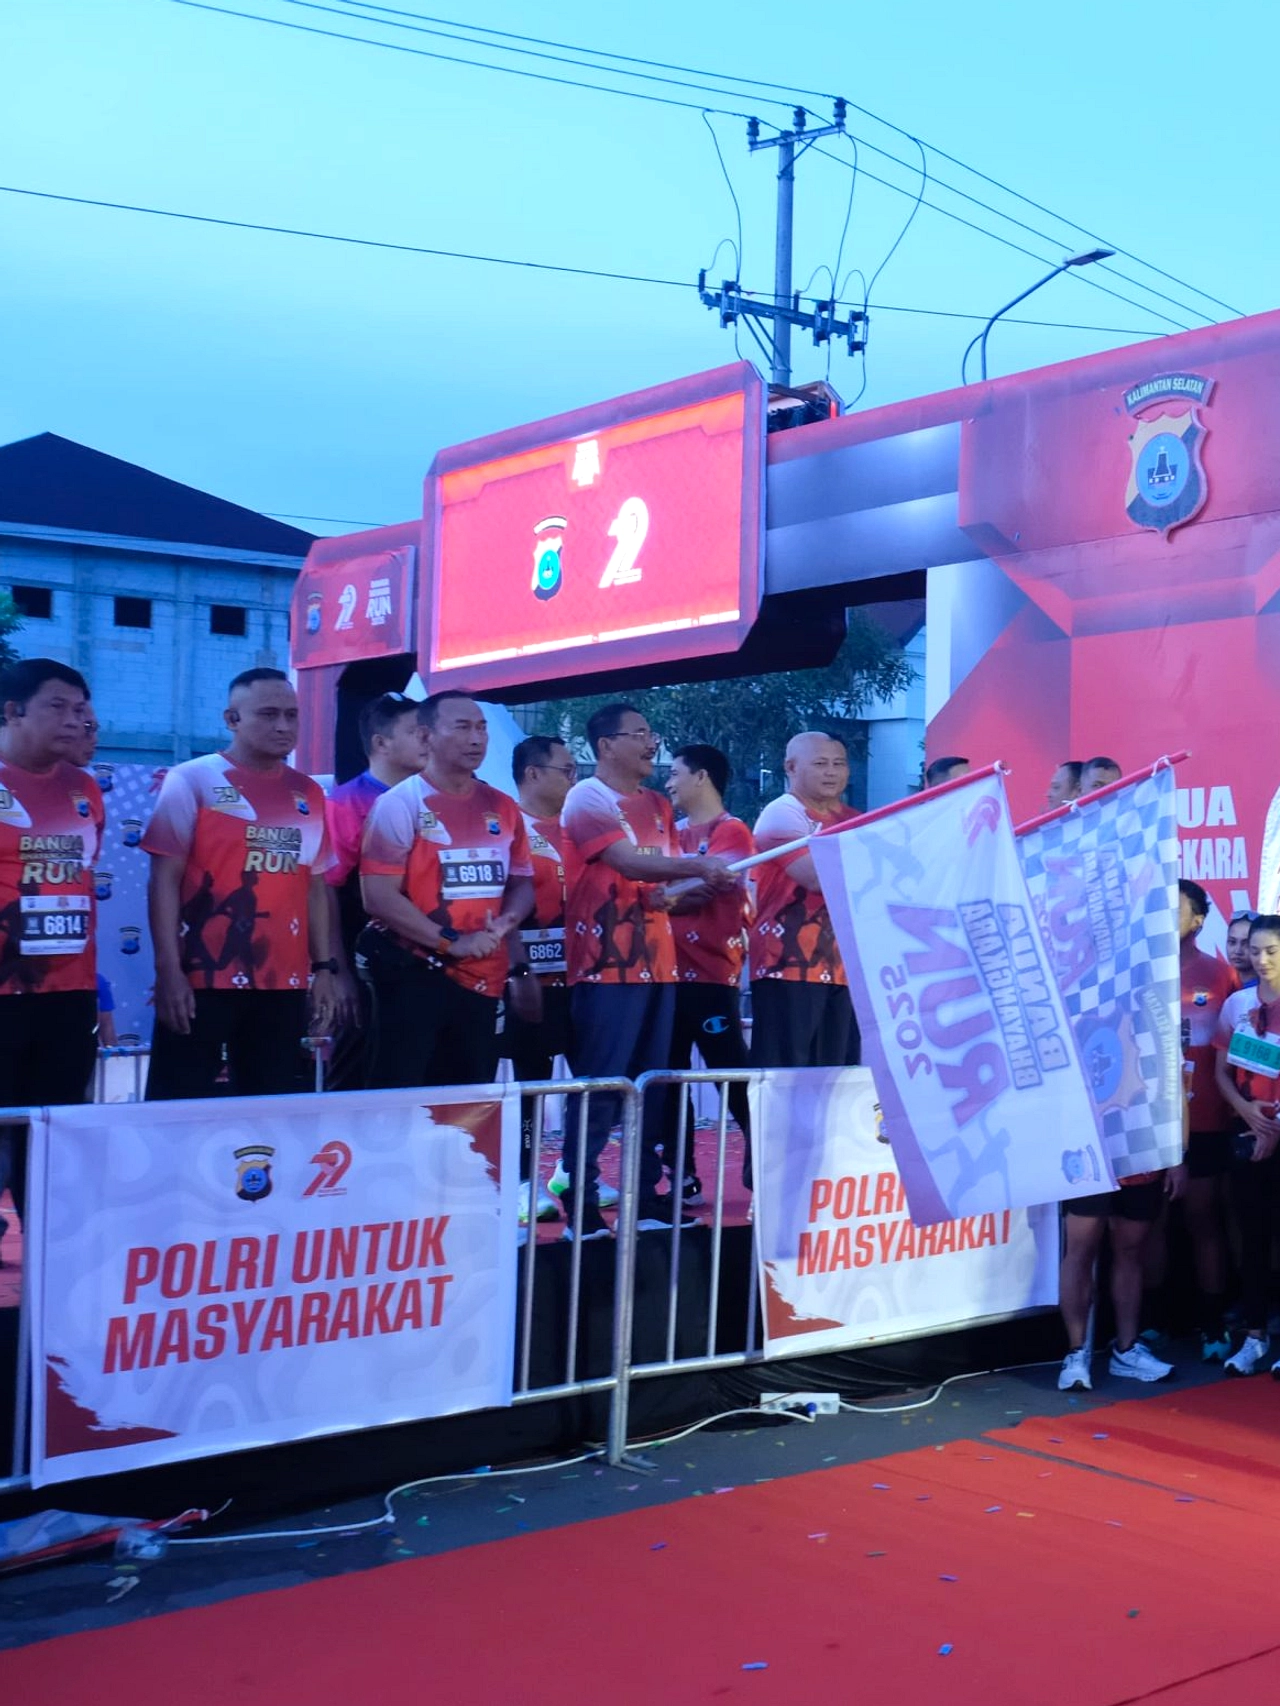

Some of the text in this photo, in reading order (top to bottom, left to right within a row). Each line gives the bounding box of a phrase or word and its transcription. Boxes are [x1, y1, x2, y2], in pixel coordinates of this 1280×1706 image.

[1126, 376, 1205, 406] KALIMANTAN SELATAN
[19, 834, 84, 852] BANUA
[245, 824, 303, 843] BANUA
[21, 861, 84, 885] RUN
[244, 850, 301, 874] RUN
[459, 864, 493, 883] 6918
[43, 915, 83, 936] 6814
[529, 942, 563, 960] 6862
[122, 1215, 452, 1305] POLRI UNTUK
[102, 1274, 454, 1375] MASYARAKAT
